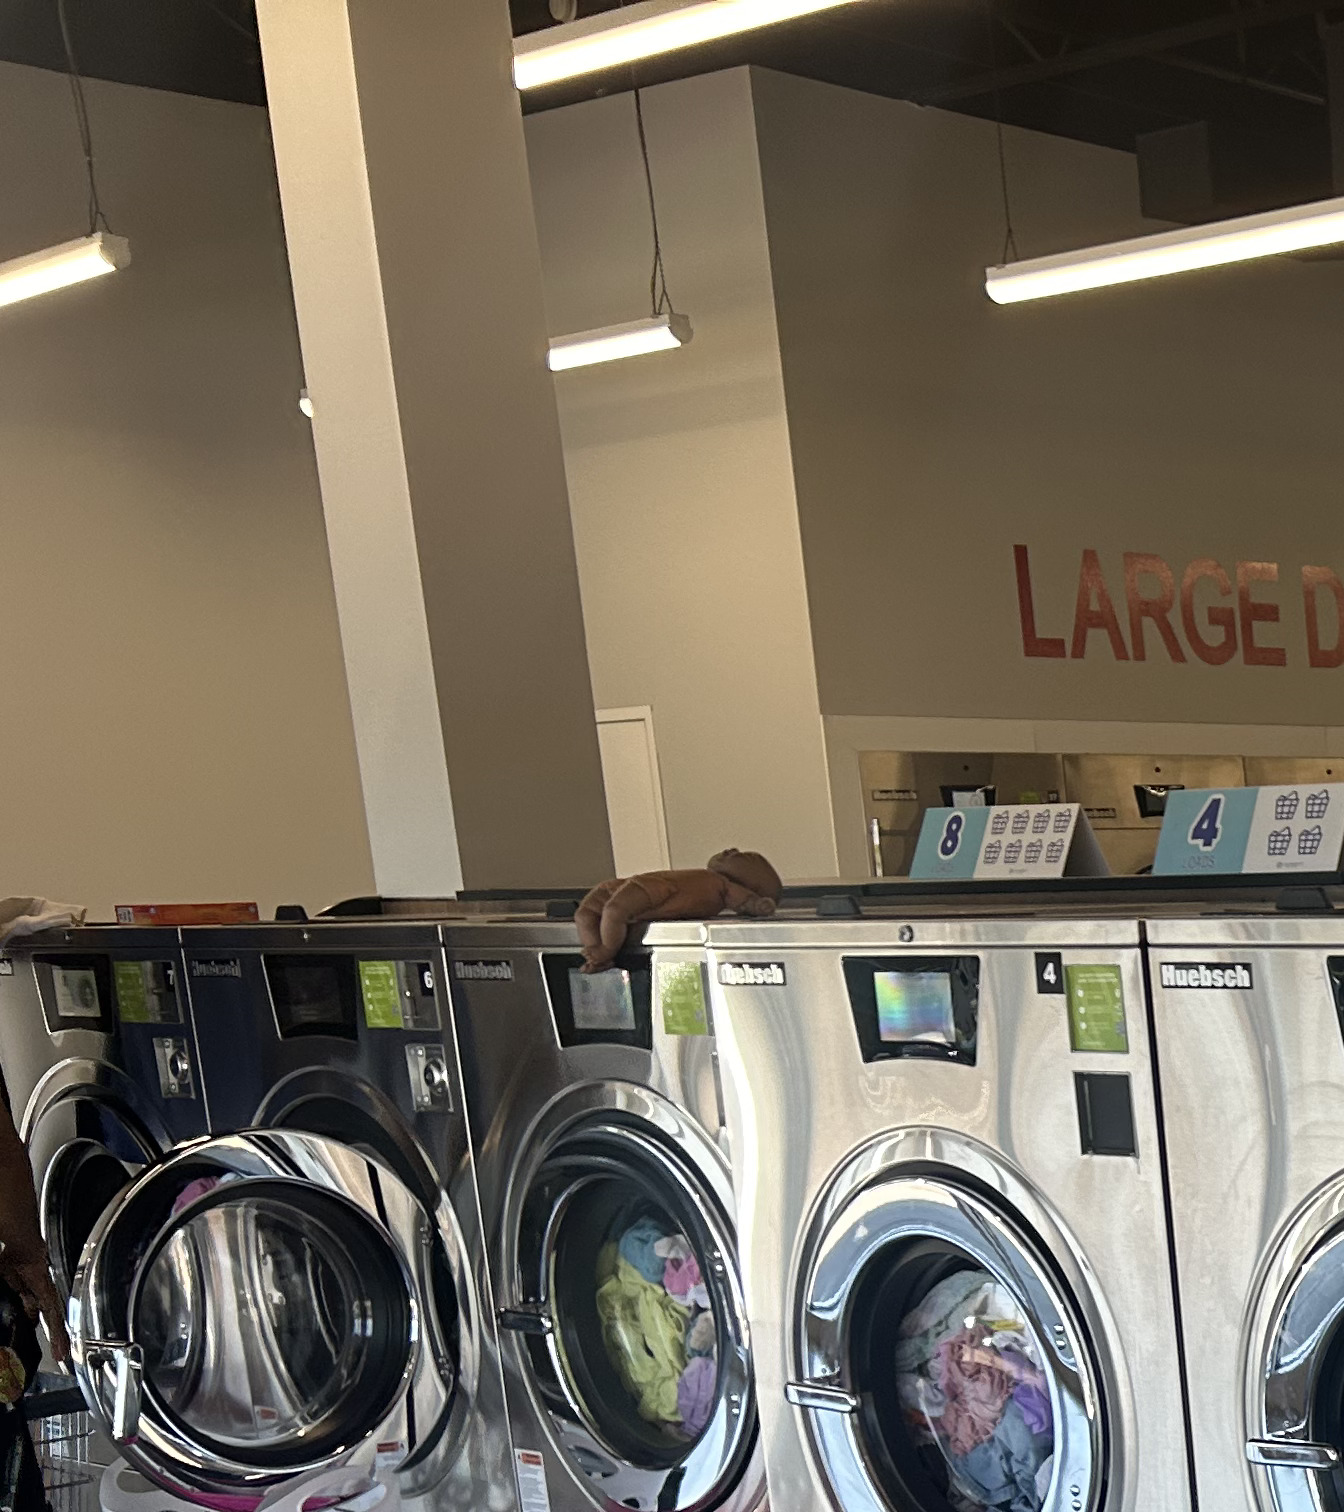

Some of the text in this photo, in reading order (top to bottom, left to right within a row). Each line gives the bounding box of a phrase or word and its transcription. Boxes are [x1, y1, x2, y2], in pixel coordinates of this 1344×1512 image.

[1013, 544, 1287, 666] LARGE
[939, 812, 963, 858] 8
[1190, 796, 1222, 848] 4
[423, 971, 434, 989] 6
[1043, 963, 1057, 984] 4
[1162, 963, 1250, 988] Huebsch
